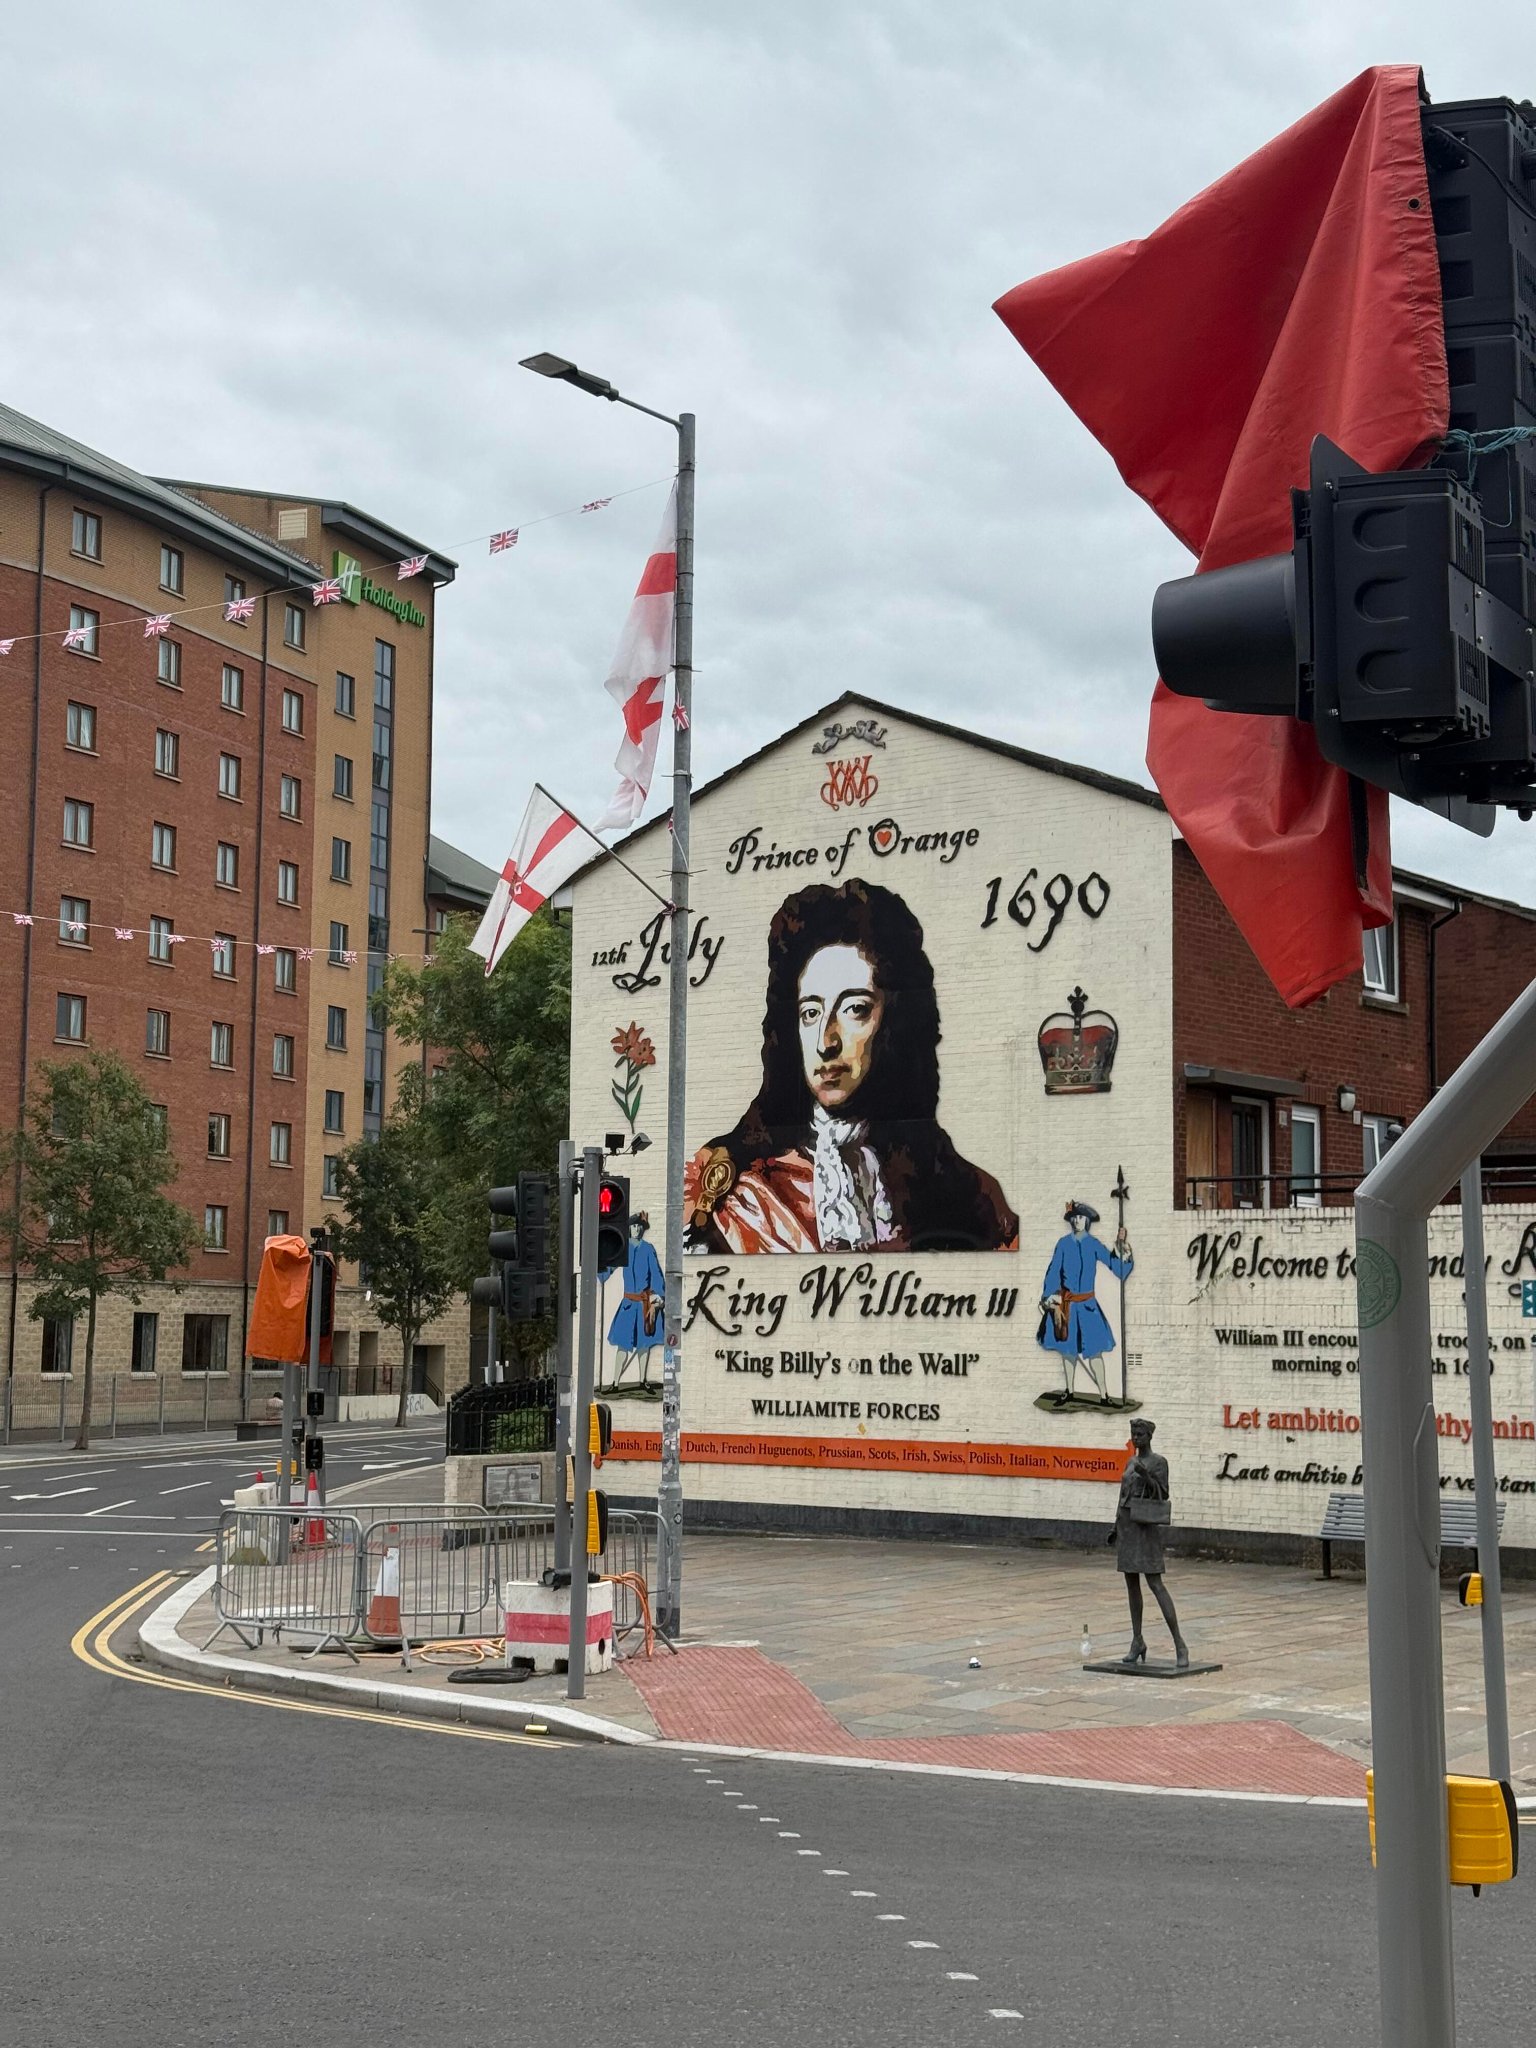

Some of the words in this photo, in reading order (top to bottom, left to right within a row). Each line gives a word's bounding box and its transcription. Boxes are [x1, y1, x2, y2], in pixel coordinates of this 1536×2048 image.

[363, 577, 408, 623] Holiday
[409, 600, 427, 628] Inn
[726, 827, 819, 875] Prince
[825, 827, 862, 877] of
[867, 818, 980, 864] Orange
[980, 867, 1111, 953] 1690
[591, 940, 632, 966] 12th
[1187, 1231, 1328, 1280] Welcome
[682, 1265, 788, 1337] King
[799, 1262, 977, 1319] William
[985, 1288, 1019, 1318] III
[1215, 1329, 1278, 1346] William
[1283, 1330, 1304, 1346] III
[1438, 1333, 1498, 1351] tro,
[1502, 1336, 1526, 1350] on
[714, 1349, 774, 1378] “King
[779, 1351, 841, 1379] Billy’s
[879, 1352, 912, 1376] the
[918, 1353, 980, 1377] Wall”
[1272, 1356, 1342, 1376] morning
[751, 1399, 861, 1419] WILLIAMITE
[866, 1402, 941, 1421] FORCES
[1222, 1404, 1261, 1430] Let
[1267, 1407, 1361, 1433] ambitio
[1492, 1414, 1535, 1441] min
[645, 1439, 683, 1454] Eng,
[686, 1440, 719, 1455] Dutch,
[721, 1441, 756, 1455] French
[758, 1443, 816, 1459] Huguenots,
[818, 1445, 866, 1460] Prussian,
[868, 1447, 900, 1461] Scots,
[902, 1448, 930, 1463] Irish,
[933, 1449, 966, 1465] Swiss,
[969, 1451, 1006, 1467] Polish,
[1009, 1453, 1050, 1469] Italian,
[1053, 1455, 1120, 1473] Norwegian.
[1216, 1453, 1270, 1481] Laat
[1274, 1462, 1348, 1484] ambitie
